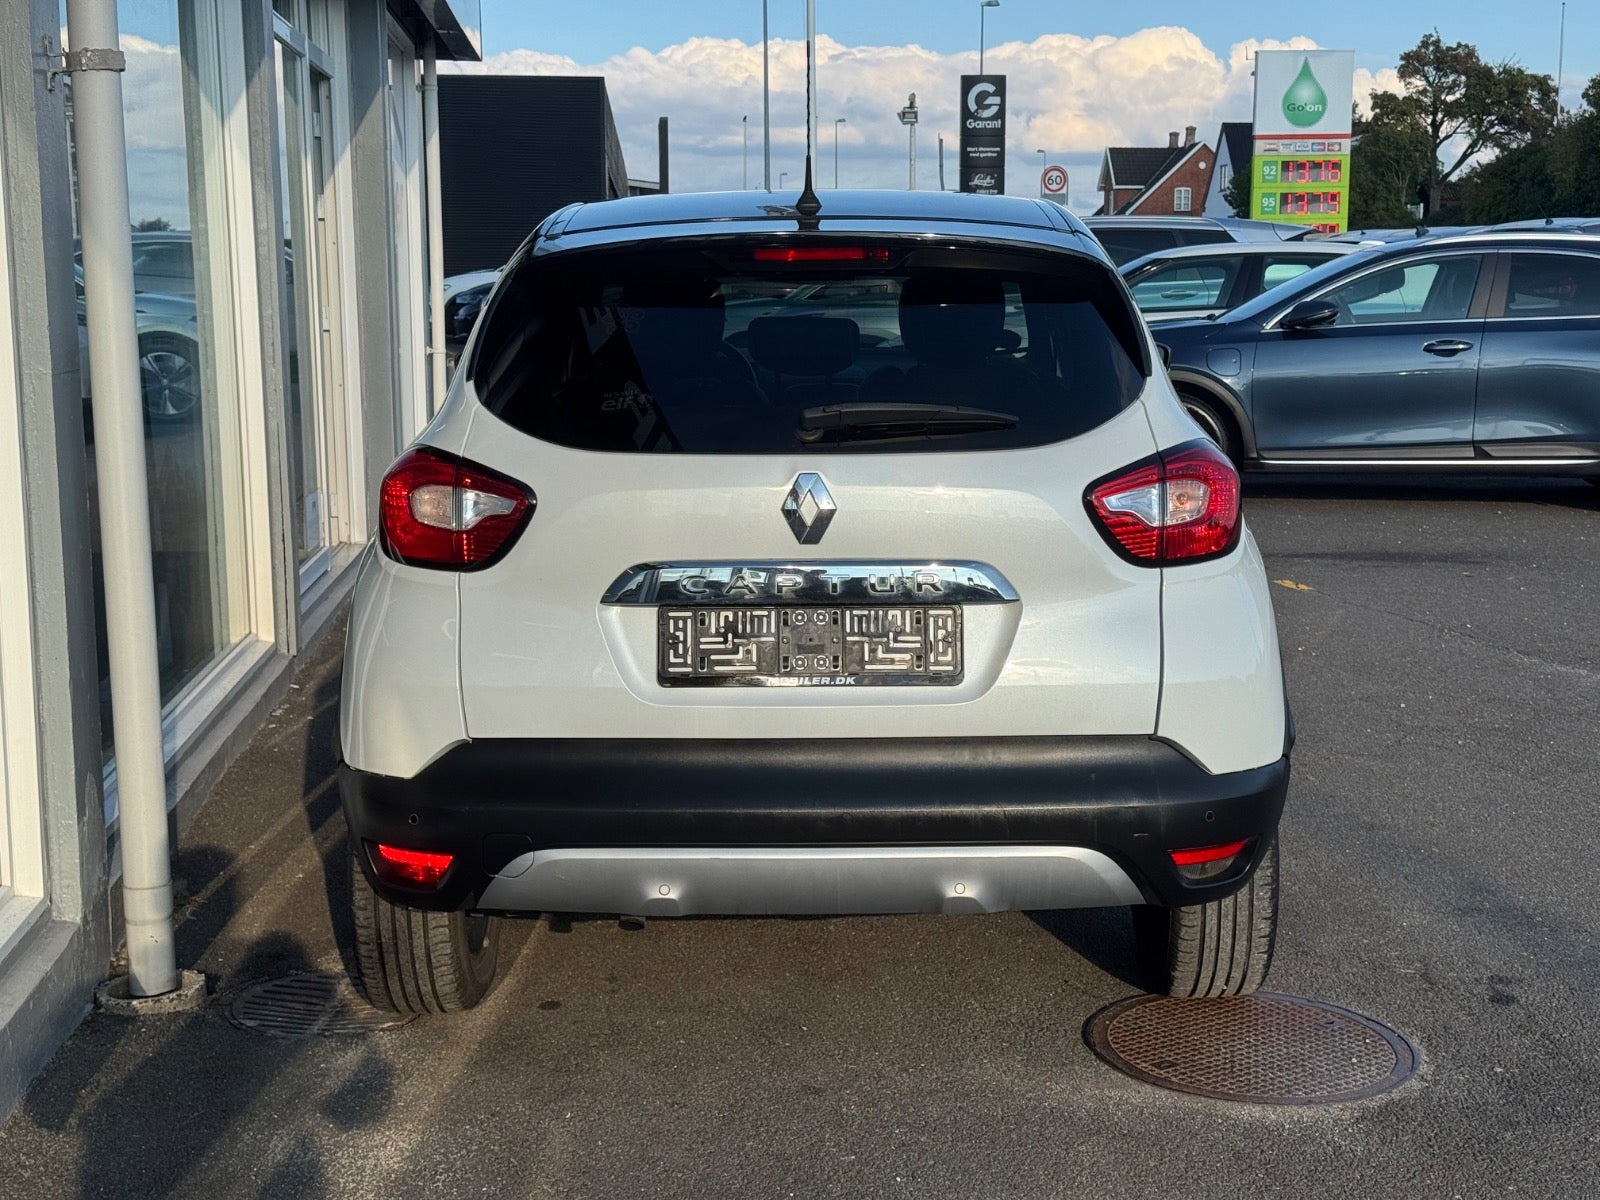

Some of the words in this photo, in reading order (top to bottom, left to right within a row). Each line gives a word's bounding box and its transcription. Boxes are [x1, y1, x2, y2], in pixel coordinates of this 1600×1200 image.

[1286, 102, 1322, 112] Go'on
[966, 119, 1002, 129] Garant
[1263, 166, 1277, 175] 92
[1047, 175, 1063, 186] 60
[1262, 198, 1276, 207] 95
[680, 573, 944, 595] CAPTUR
